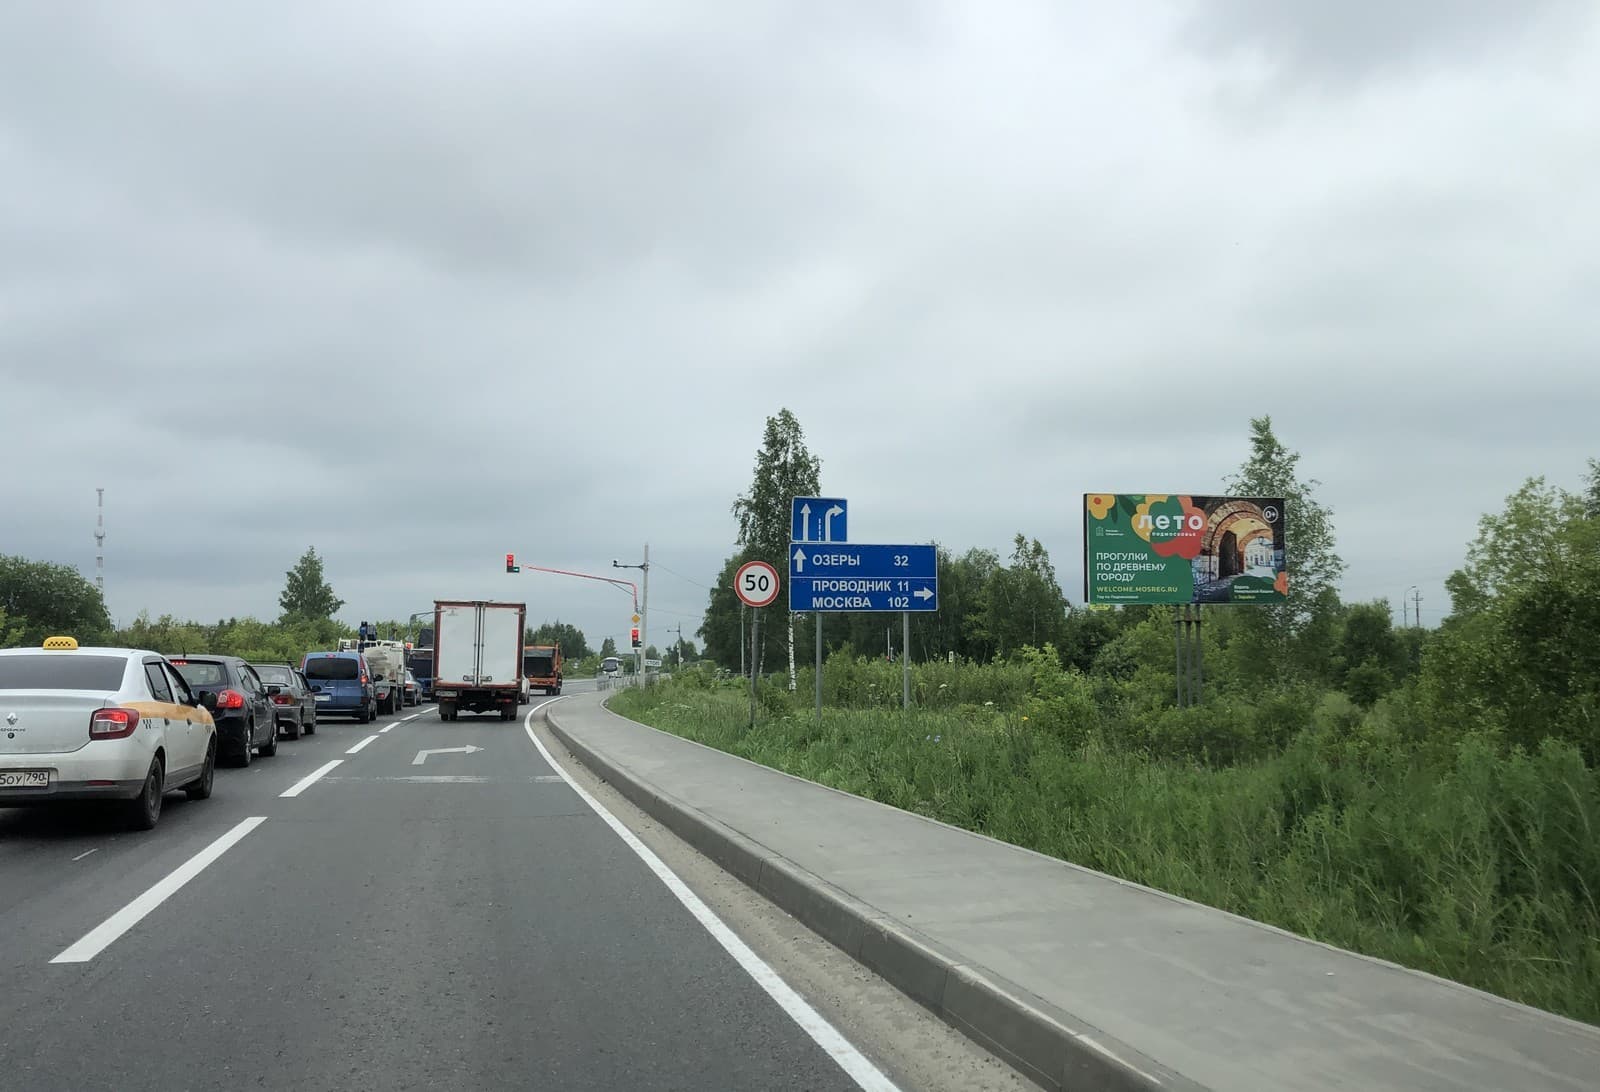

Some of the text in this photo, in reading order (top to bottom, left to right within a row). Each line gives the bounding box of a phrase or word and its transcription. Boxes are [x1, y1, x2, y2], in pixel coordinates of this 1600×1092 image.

[812, 554, 909, 567] ОЗЕРЫ 32
[1096, 552, 1148, 561] ПРОГУЛКИ
[1096, 562, 1166, 572] ПО ДРЕВНЕМУ
[745, 575, 769, 592] 50
[1096, 573, 1135, 582] ГОРОДУ
[812, 580, 909, 593] ПРОВОДНИК 11
[812, 596, 909, 608] МОСКВА 102
